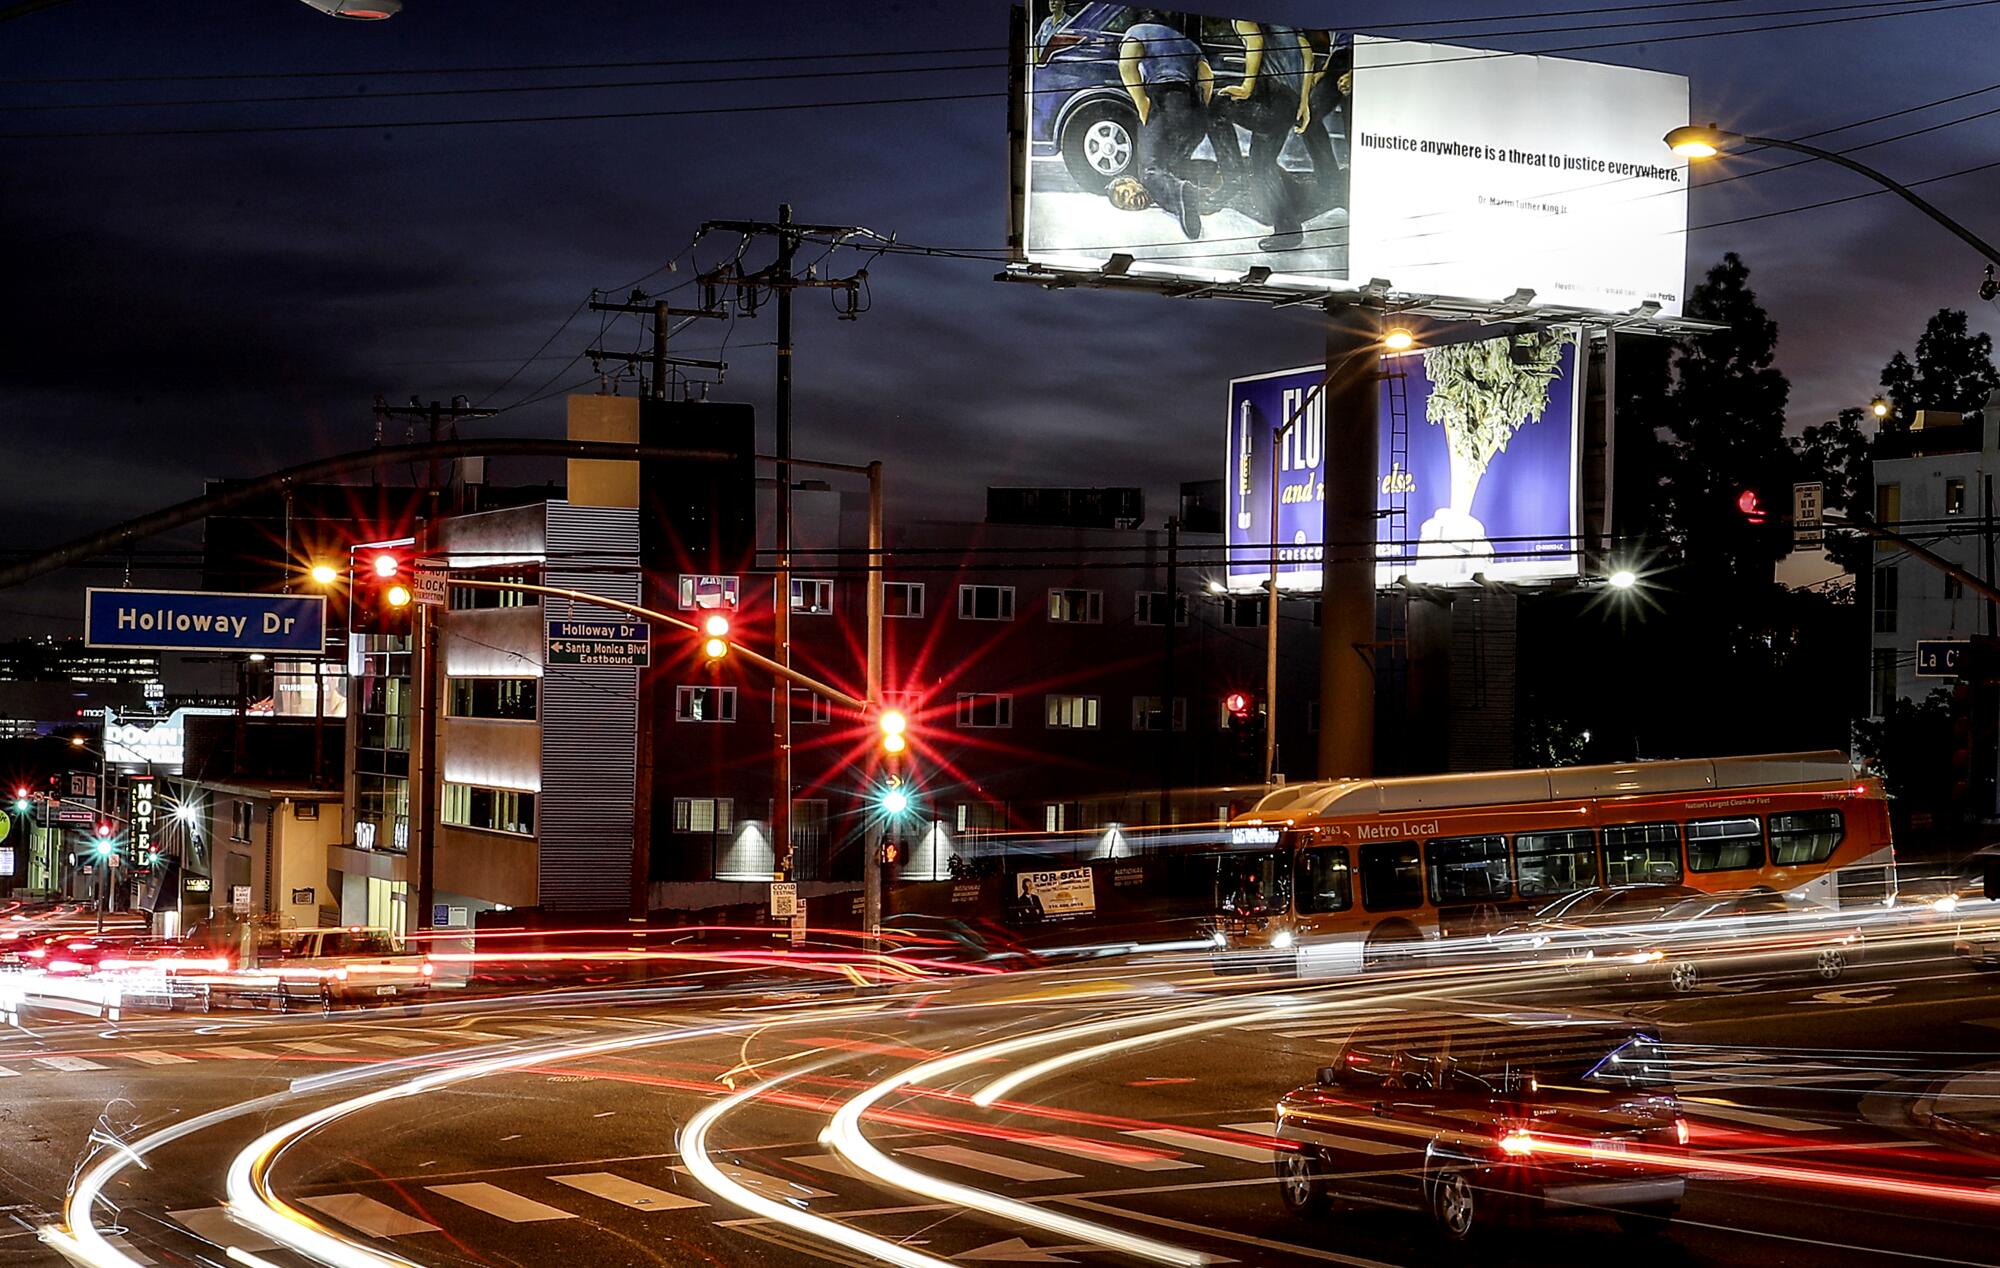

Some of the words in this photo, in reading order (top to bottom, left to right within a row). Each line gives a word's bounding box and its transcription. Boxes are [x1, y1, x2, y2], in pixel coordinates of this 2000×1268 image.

[1361, 132, 1417, 150] Injustice
[1420, 139, 1481, 159] anywhere
[1484, 145, 1496, 161] is
[1498, 150, 1506, 162] a
[1509, 149, 1546, 166] threat
[1549, 153, 1561, 168] to
[1563, 154, 1605, 173] justice
[1608, 161, 1681, 183] everywhere.
[1516, 200, 1541, 211] Luther
[1542, 203, 1559, 215] King
[1282, 384, 1327, 471] FLO
[1282, 472, 1316, 504] and
[1382, 462, 1416, 495] else.
[1279, 547, 1322, 560] CRESCO
[414, 578, 445, 592] BLOCK
[118, 607, 247, 638] Holloway
[263, 612, 295, 634] Dr
[562, 623, 615, 638] Holloway
[621, 625, 635, 637] Dr
[565, 642, 591, 653] Santa
[594, 643, 624, 654] Monica
[627, 644, 647, 655] Blvd
[580, 654, 634, 664] Eastbound
[1920, 650, 1937, 667] La
[137, 783, 153, 866] MOTEL
[1320, 826, 1341, 836] 3963
[1357, 824, 1399, 839] Metro
[1403, 820, 1440, 836] Local
[1032, 873, 1057, 883] FOR
[1060, 868, 1091, 880] SALE
